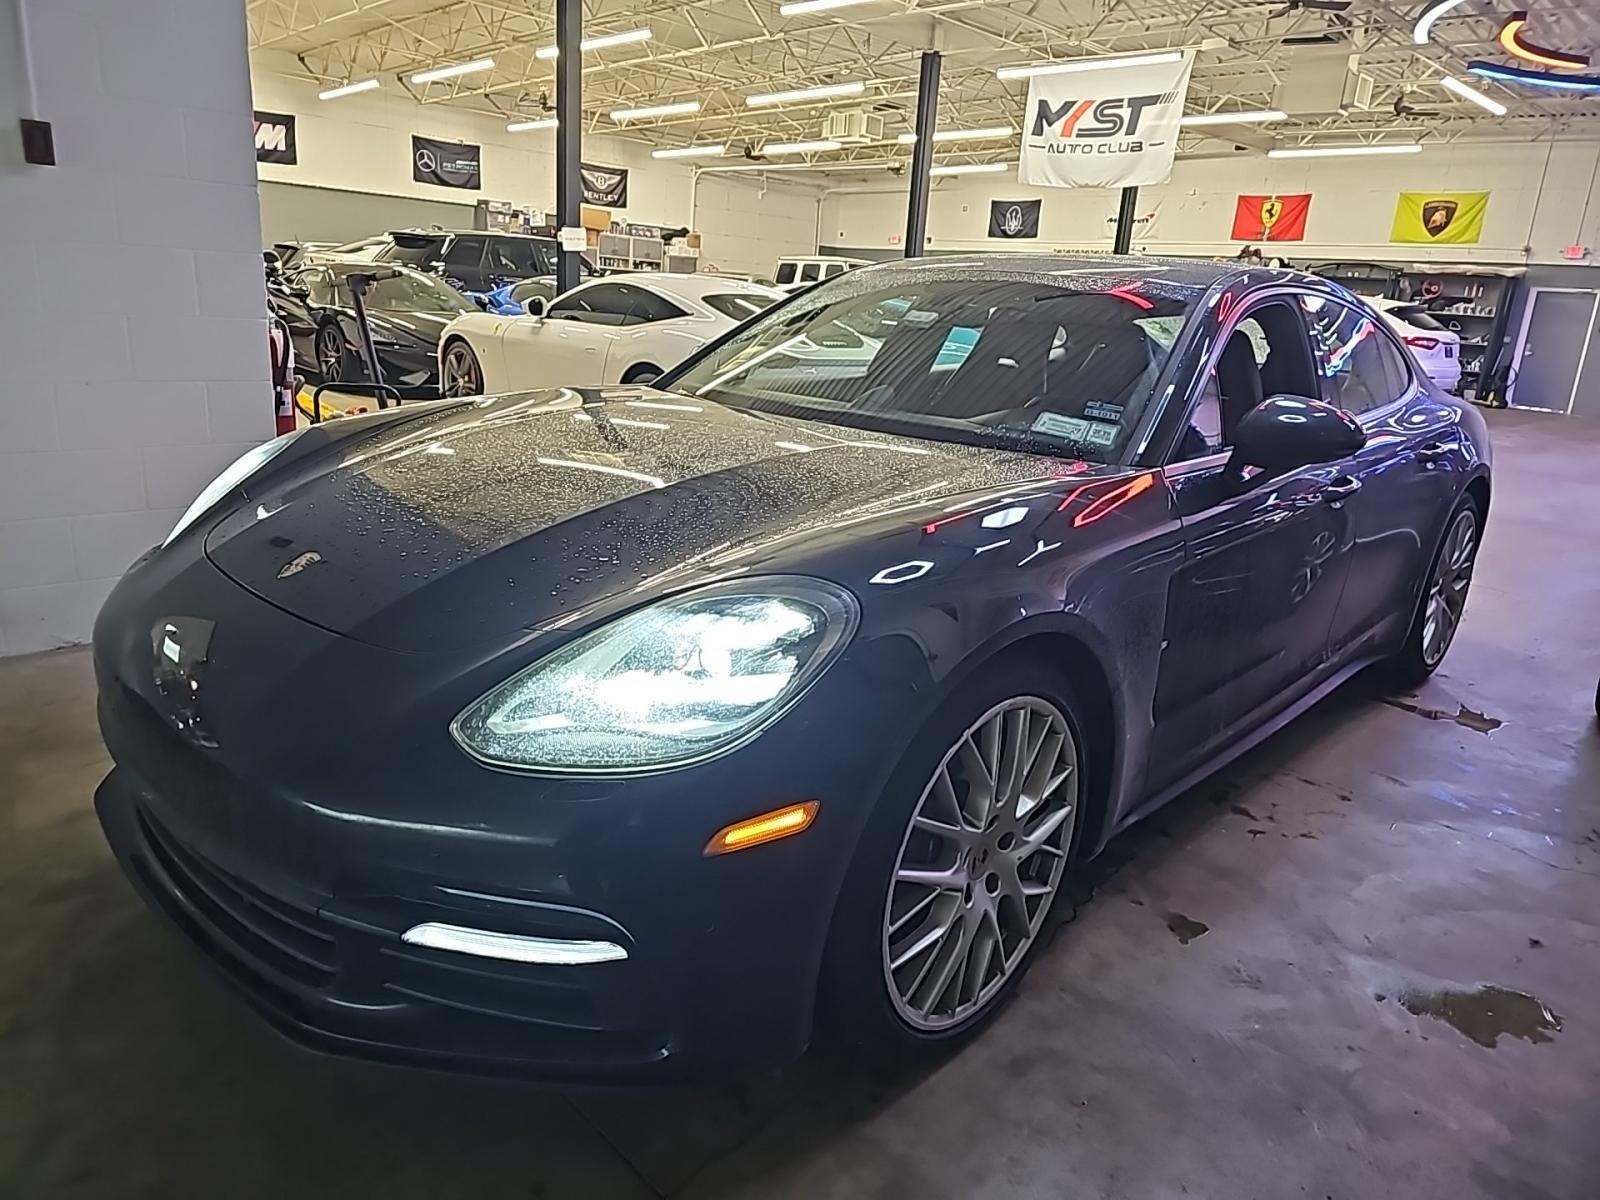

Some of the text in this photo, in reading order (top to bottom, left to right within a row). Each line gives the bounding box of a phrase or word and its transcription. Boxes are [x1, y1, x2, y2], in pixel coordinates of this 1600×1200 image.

[1047, 141, 1144, 154] AUTO CLUB
[583, 190, 619, 201] BENTLEY
